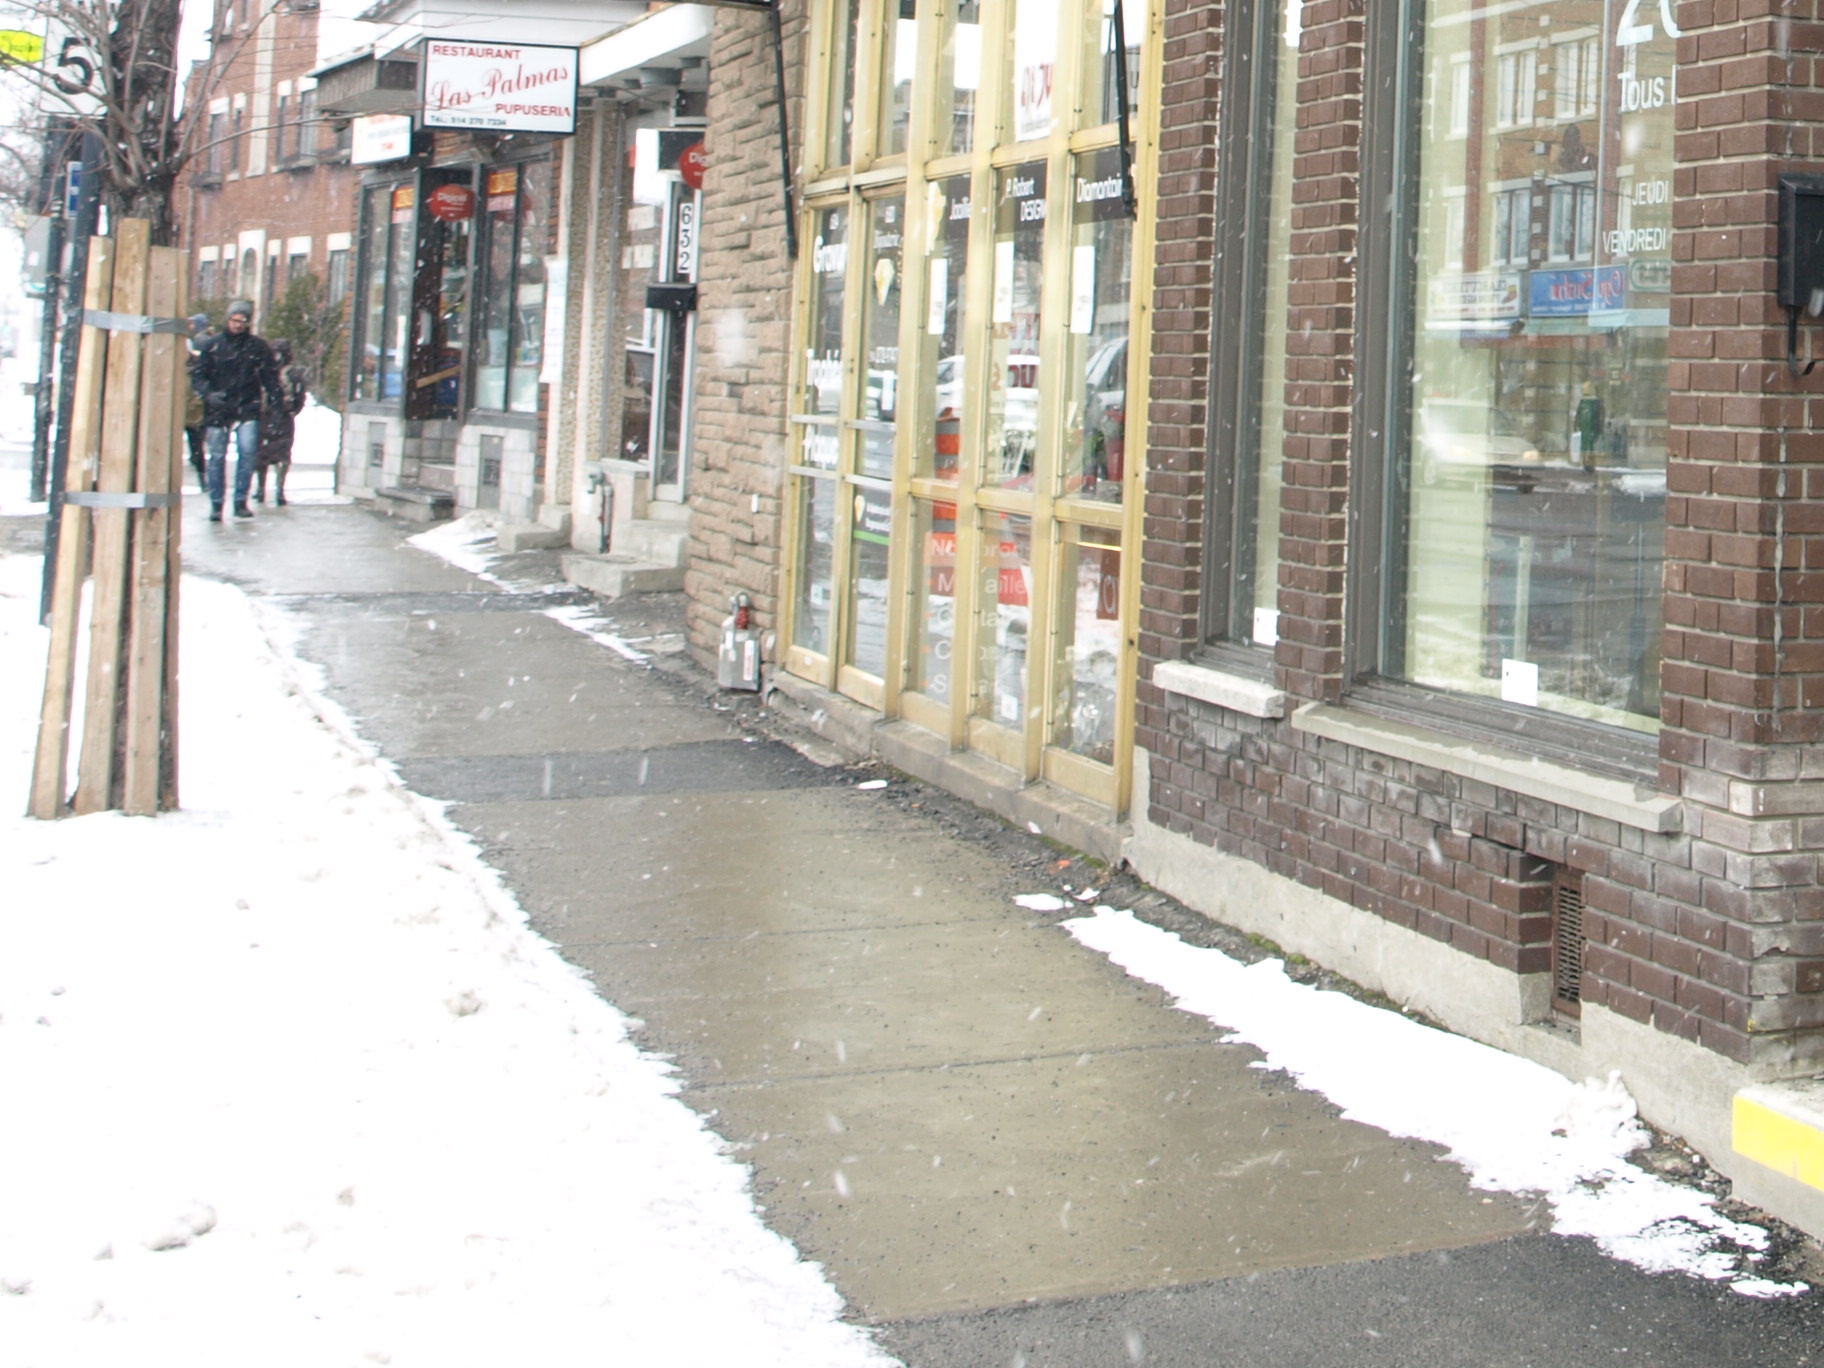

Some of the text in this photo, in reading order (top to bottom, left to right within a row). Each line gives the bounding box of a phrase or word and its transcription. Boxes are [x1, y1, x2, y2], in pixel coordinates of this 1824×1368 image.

[432, 44, 522, 59] RESTAURANT
[481, 63, 569, 101] Palmas
[1617, 71, 1665, 113] Tous
[495, 102, 571, 118] PUPUSERIA
[1632, 180, 1668, 206] JEUDI
[1603, 228, 1666, 254] VENDREDI
